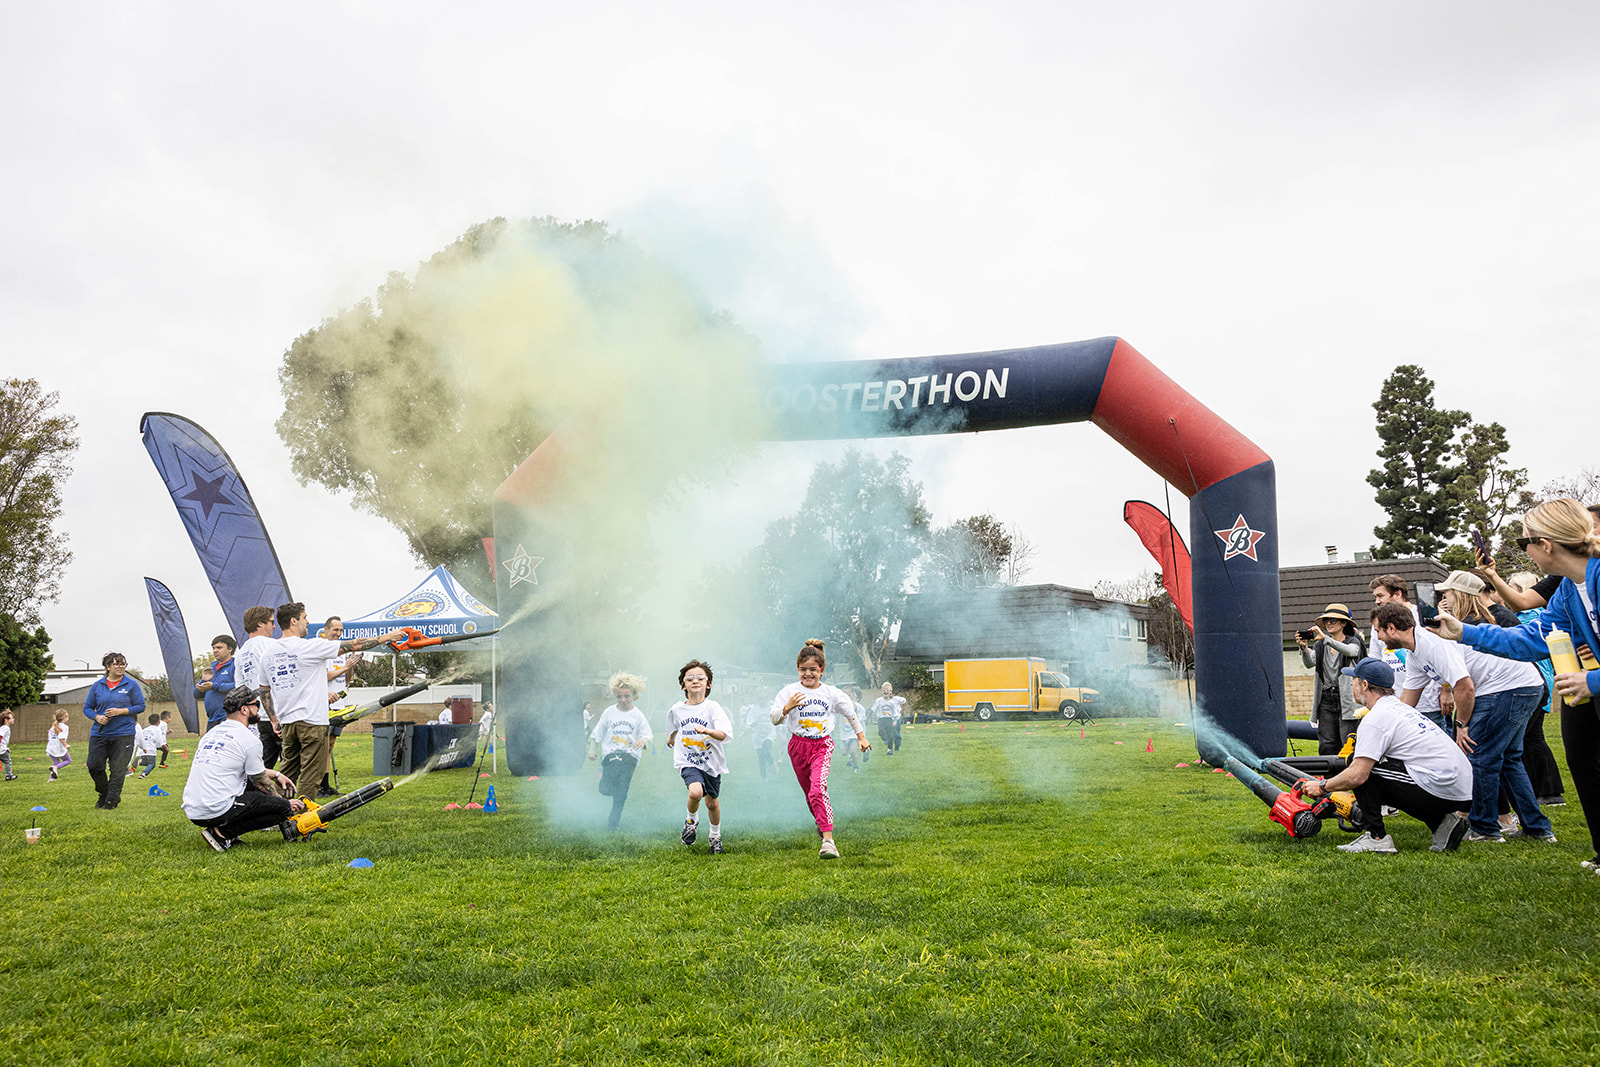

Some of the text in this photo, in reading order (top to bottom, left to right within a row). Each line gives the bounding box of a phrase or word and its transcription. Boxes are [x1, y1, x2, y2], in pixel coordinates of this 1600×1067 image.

[746, 367, 1010, 415] OOSTERTHON
[1227, 526, 1251, 553] B
[338, 626, 378, 641] ALIFORNIA
[428, 623, 459, 636] SCHOOL
[680, 717, 708, 728] ALIFORNIA
